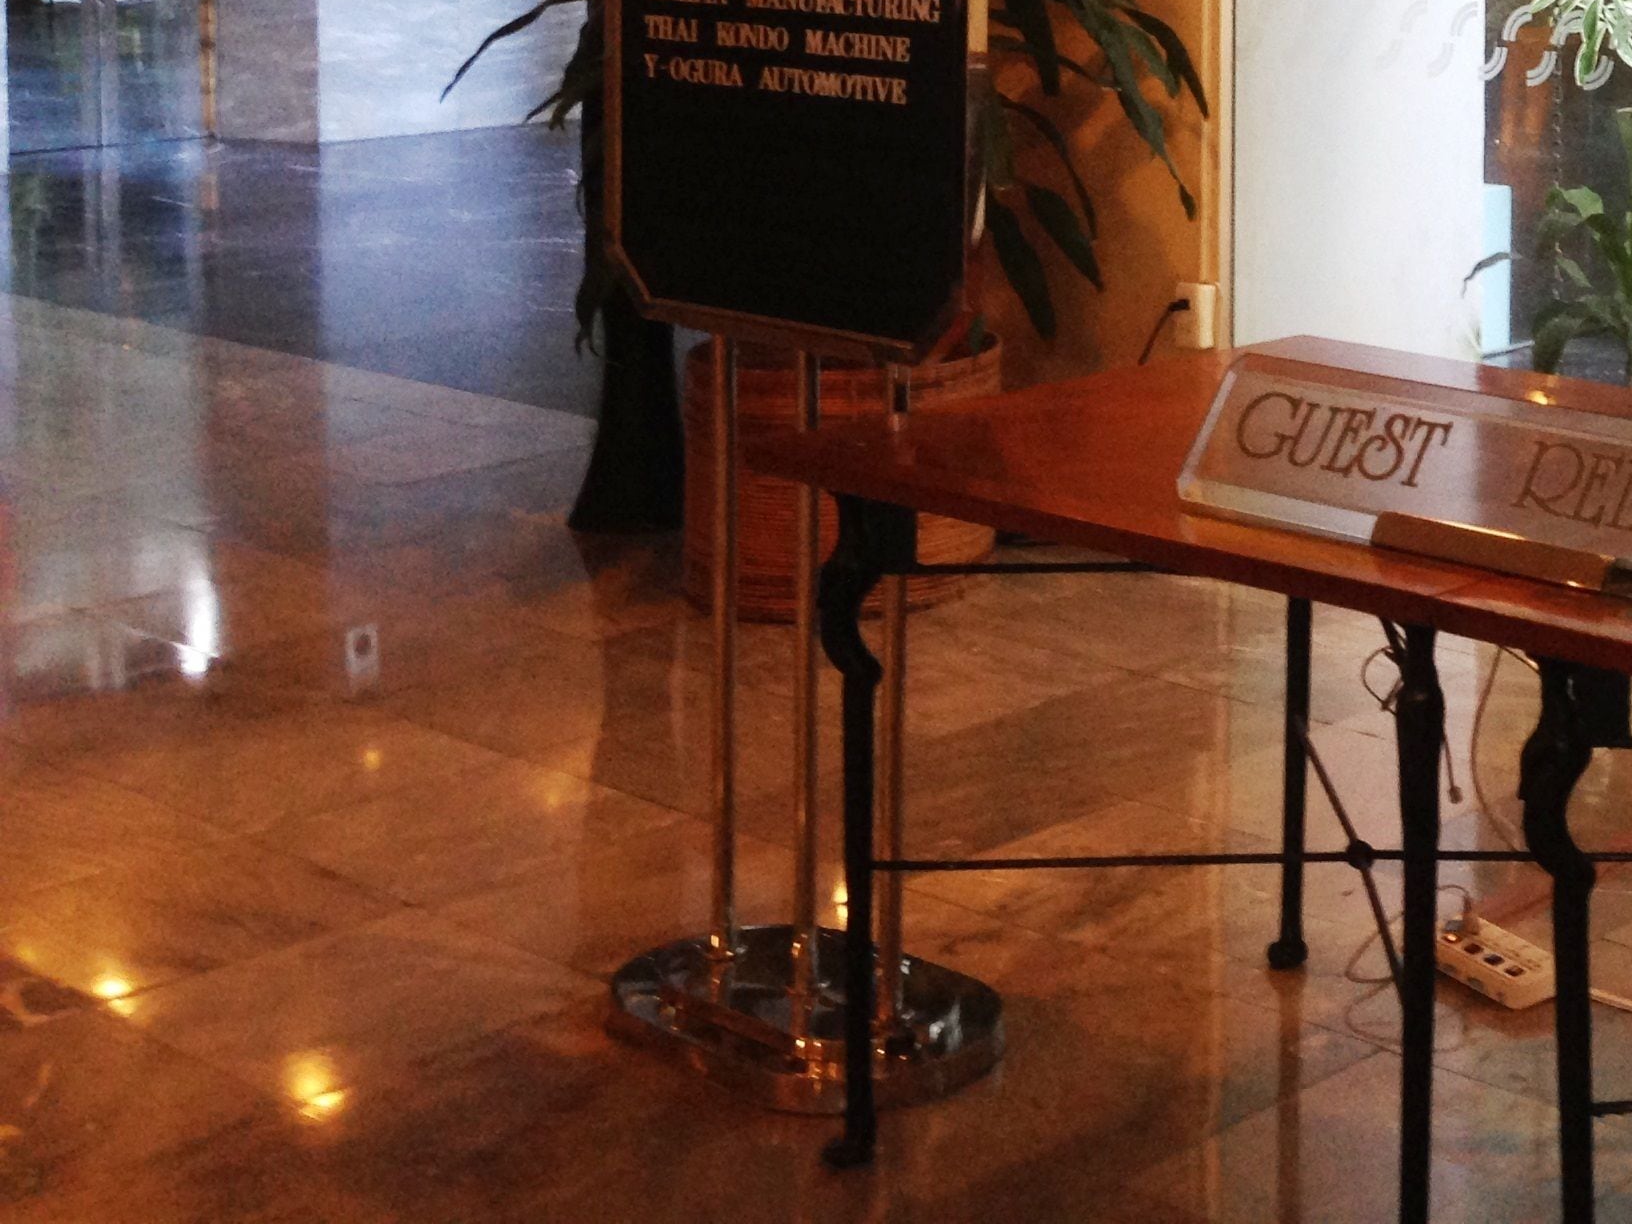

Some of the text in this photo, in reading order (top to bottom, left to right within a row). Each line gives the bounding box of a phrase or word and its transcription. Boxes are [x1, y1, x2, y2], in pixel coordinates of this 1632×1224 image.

[644, 14, 699, 43] THAI
[804, 29, 911, 63] MACHINE
[759, 65, 907, 105] AUTOMOTIVE
[1235, 391, 1453, 489] GUEST
